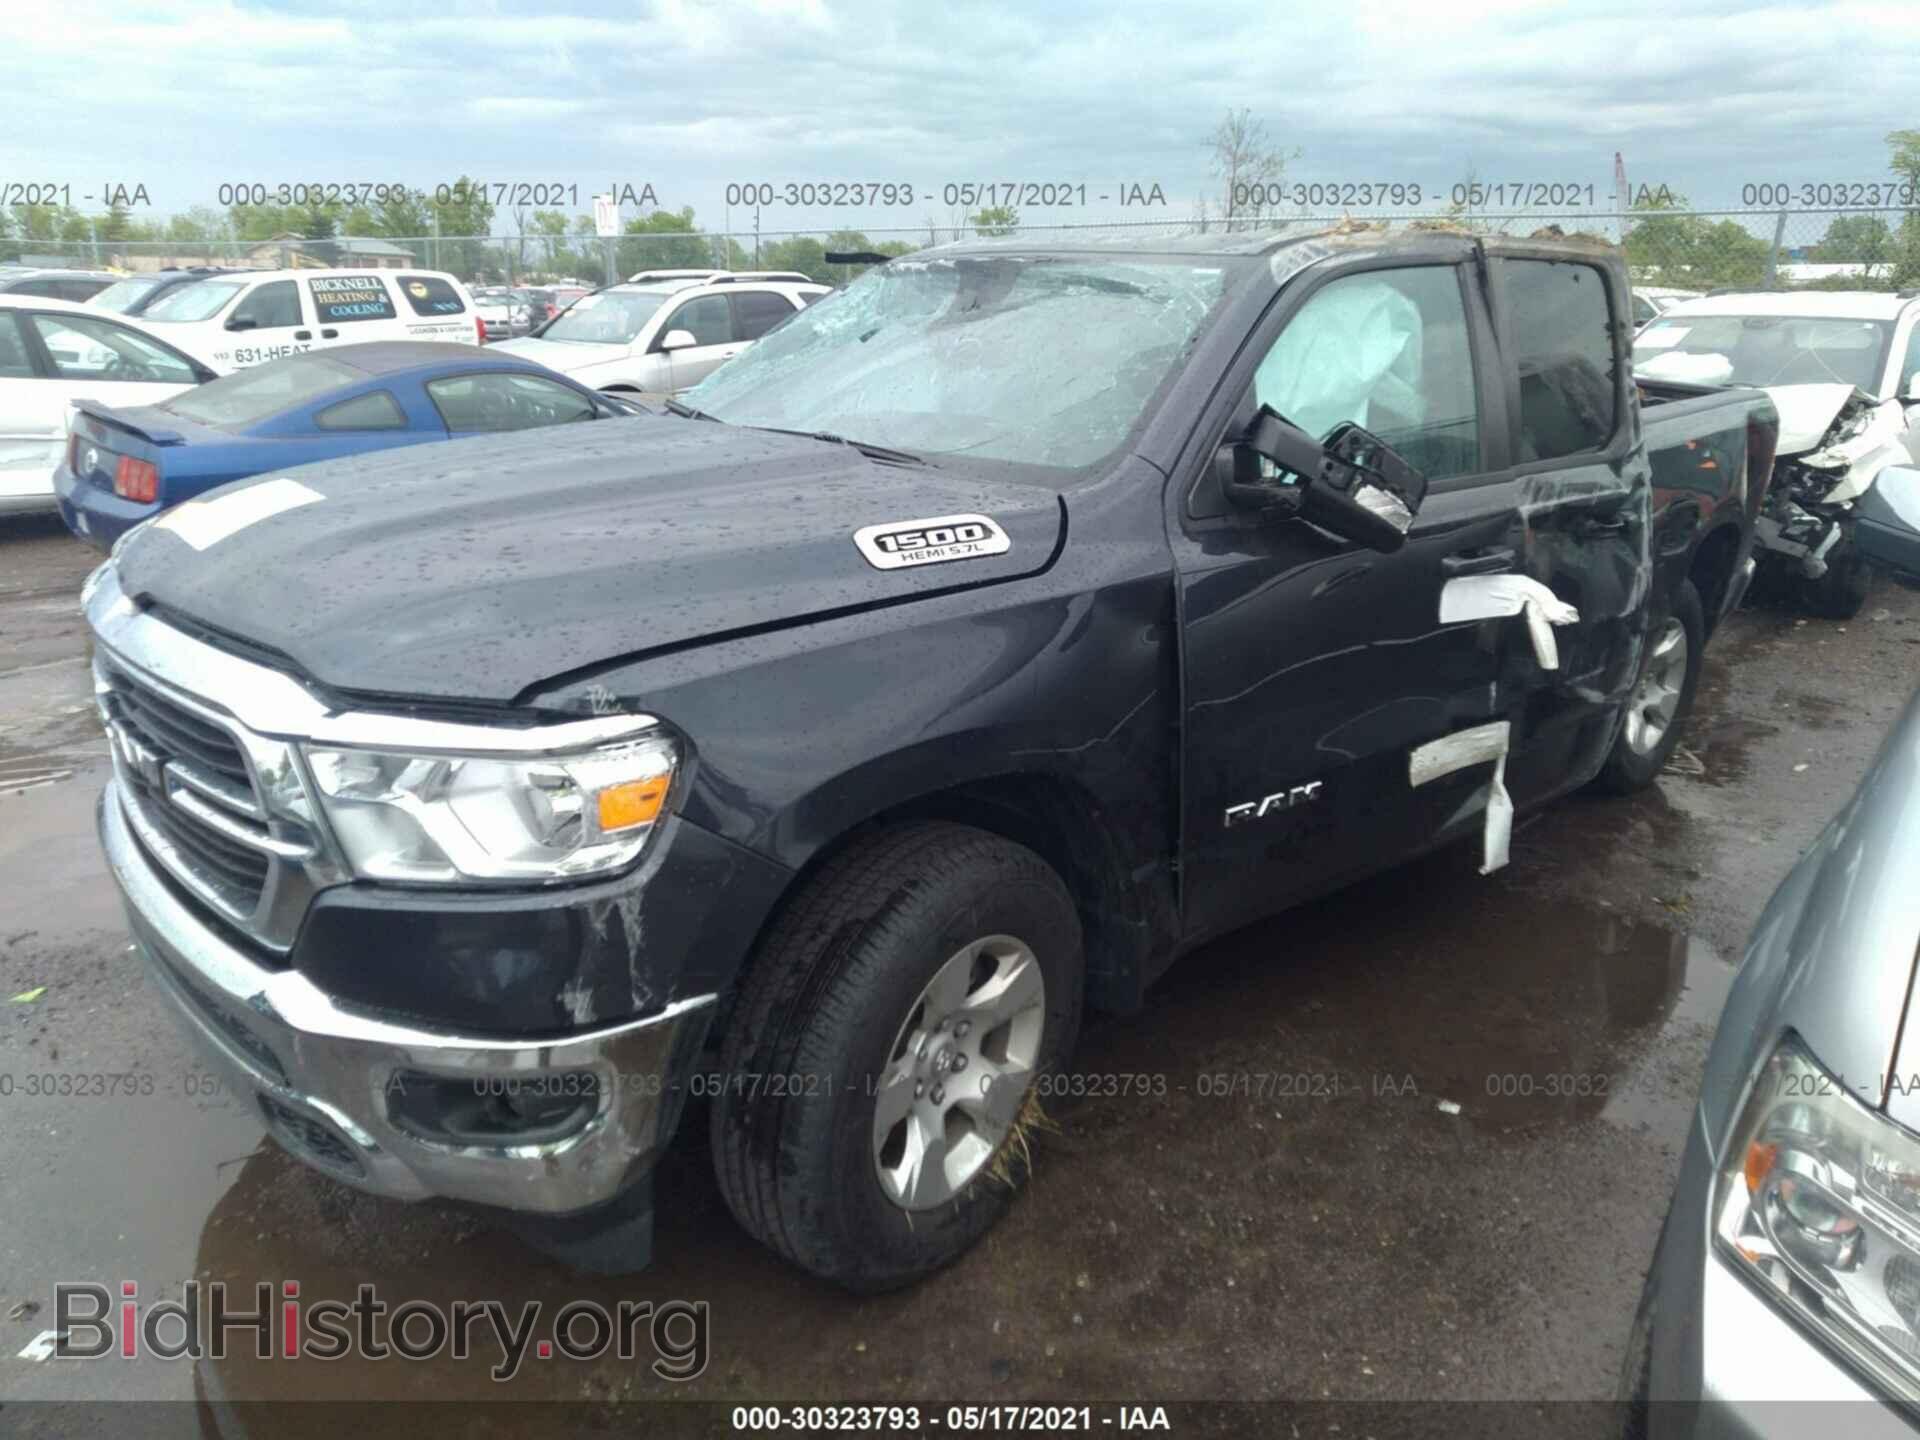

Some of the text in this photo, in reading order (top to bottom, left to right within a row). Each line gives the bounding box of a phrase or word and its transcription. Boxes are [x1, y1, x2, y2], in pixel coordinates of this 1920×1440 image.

[310, 277, 384, 291] BICKNELL
[317, 291, 389, 304] HEATING &
[330, 302, 384, 316] COOLING
[876, 522, 990, 552] 1500
[901, 548, 946, 561] HEMI
[1224, 781, 1322, 827] RAM
